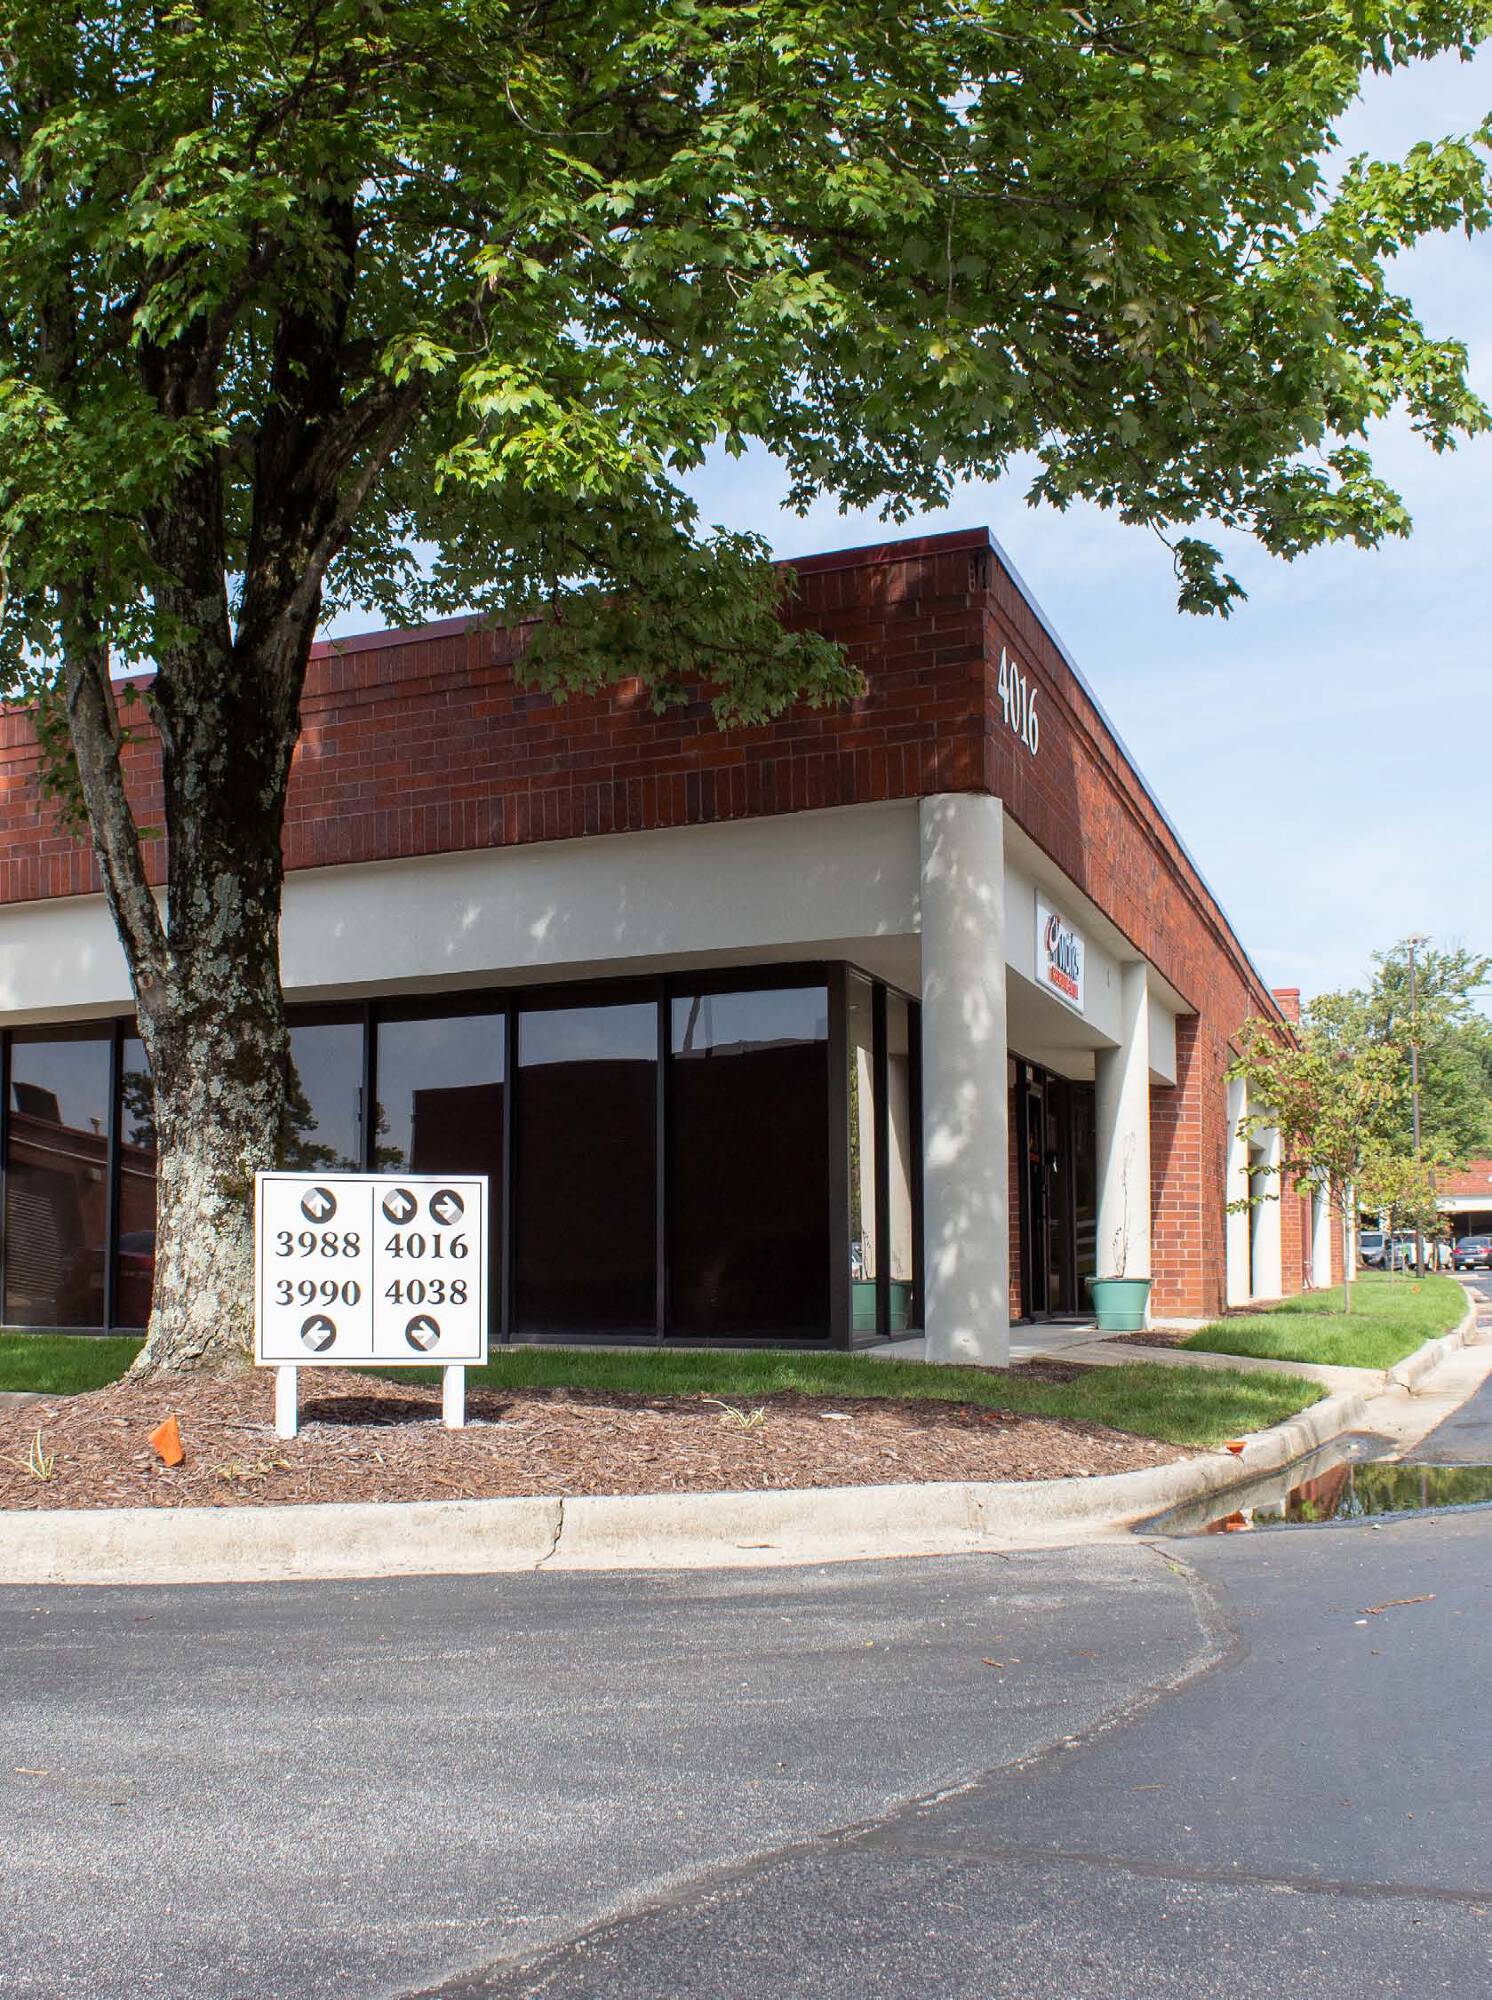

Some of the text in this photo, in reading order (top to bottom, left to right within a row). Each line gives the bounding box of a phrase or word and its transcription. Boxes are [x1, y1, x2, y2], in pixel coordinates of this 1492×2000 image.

[998, 646, 1039, 756] 4016
[275, 1231, 361, 1258] 3988
[384, 1232, 469, 1259] 4016
[275, 1279, 361, 1306] 3990
[384, 1279, 468, 1305] 4038
